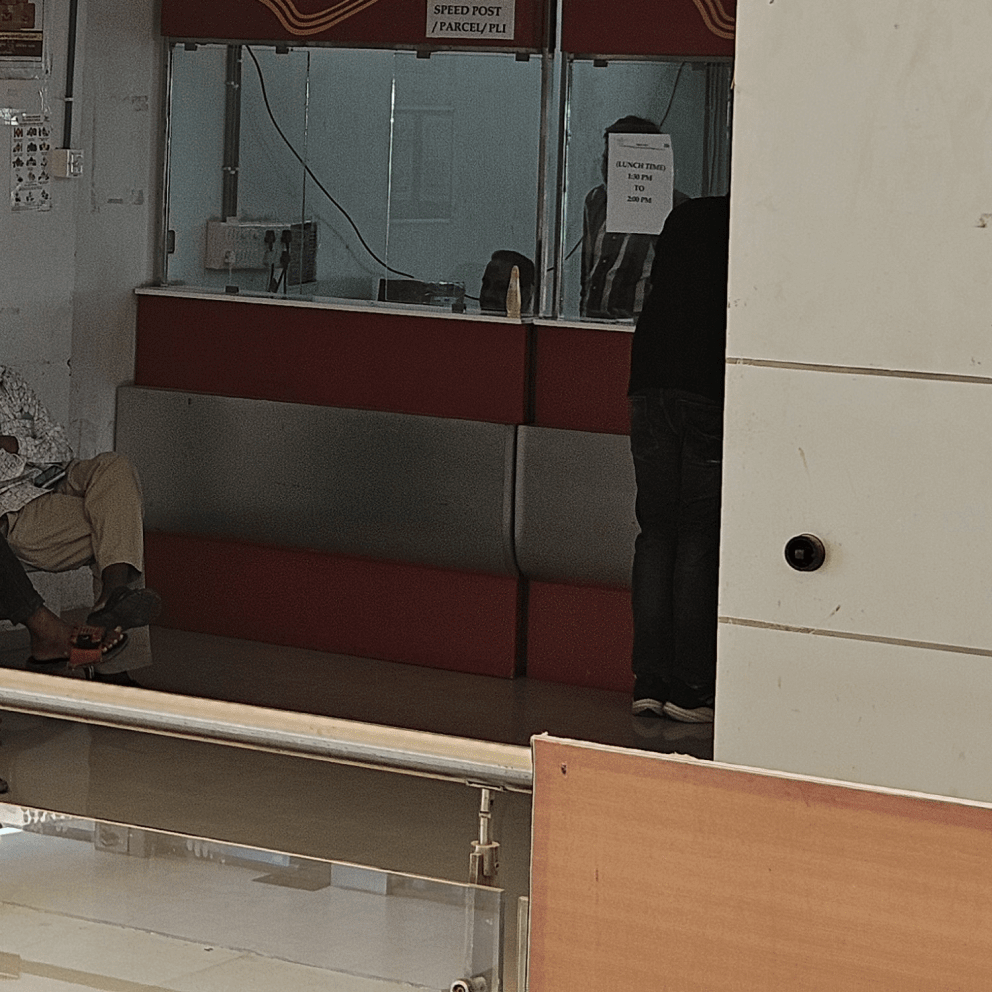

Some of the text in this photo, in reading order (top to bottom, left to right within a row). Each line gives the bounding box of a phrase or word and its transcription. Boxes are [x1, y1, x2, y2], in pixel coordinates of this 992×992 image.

[433, 5, 502, 16] SPEED POST
[488, 23, 507, 33] PLI
[616, 160, 666, 172] (LUNCH TIME)
[633, 184, 645, 192] TO
[640, 196, 652, 204] PM
